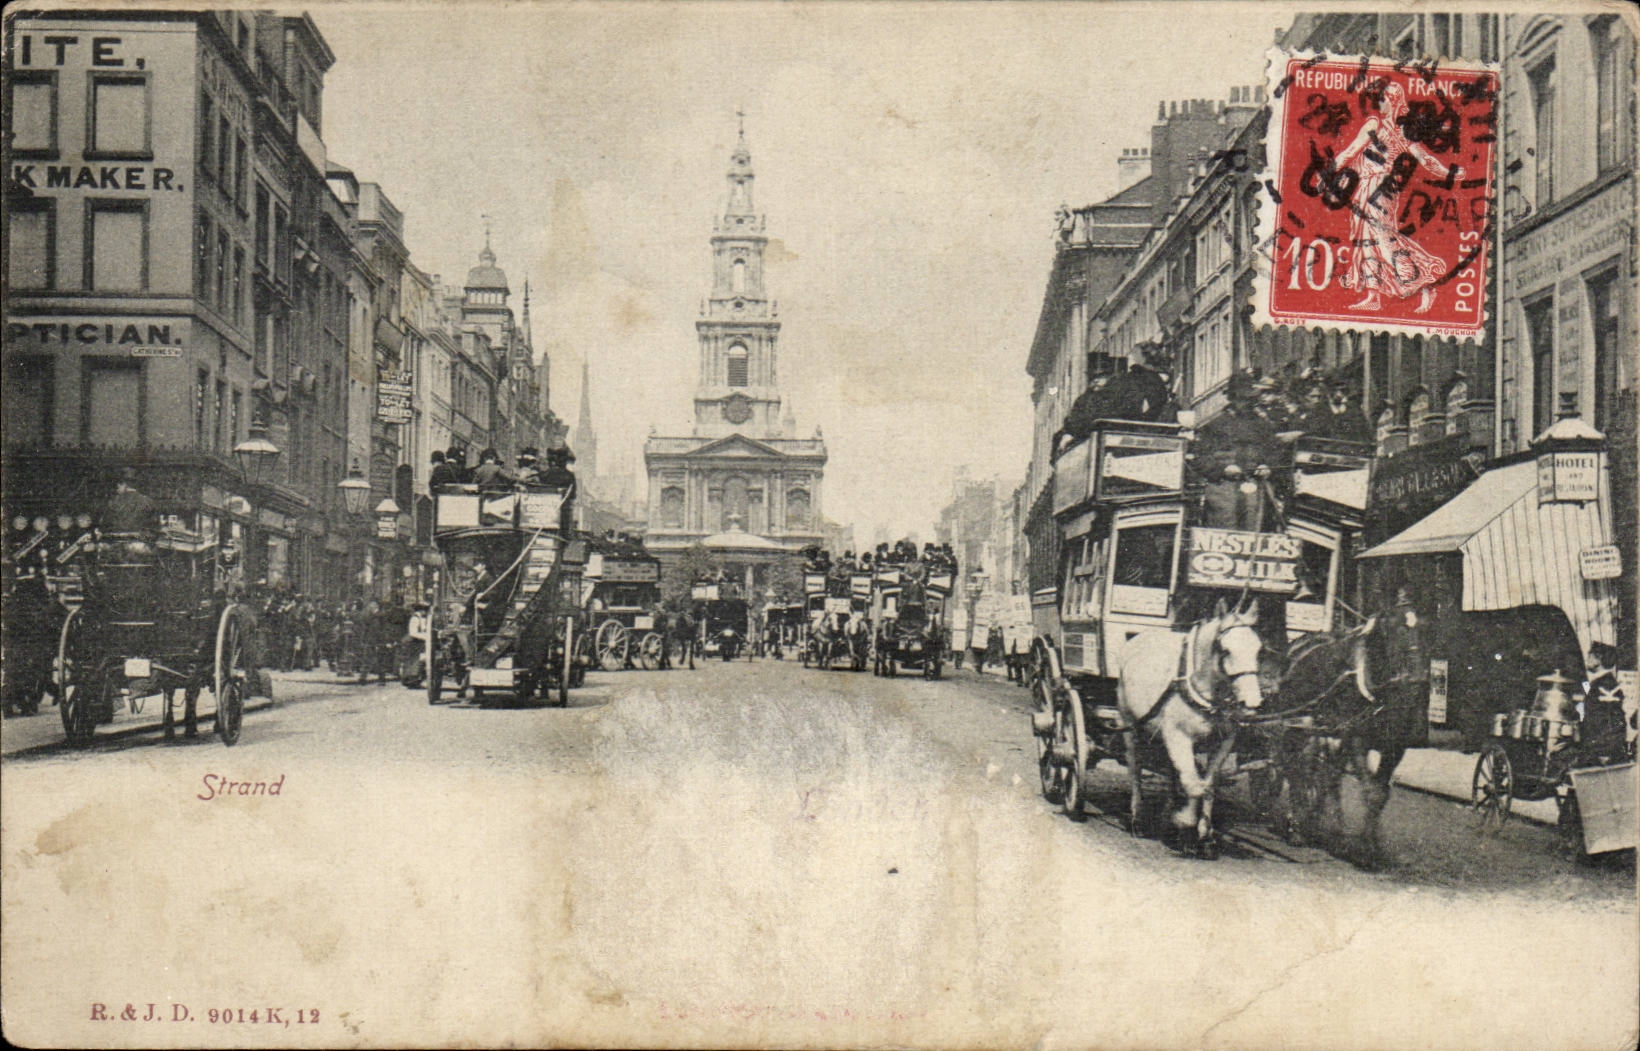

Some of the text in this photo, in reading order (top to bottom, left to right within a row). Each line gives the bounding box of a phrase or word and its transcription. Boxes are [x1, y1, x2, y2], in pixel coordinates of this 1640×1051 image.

[22, 35, 145, 70] ITE,
[47, 166, 184, 192] MAKER.
[7, 322, 182, 345] PTICIAN.
[1556, 458, 1593, 468] HOTEL
[1234, 558, 1298, 581] MILK
